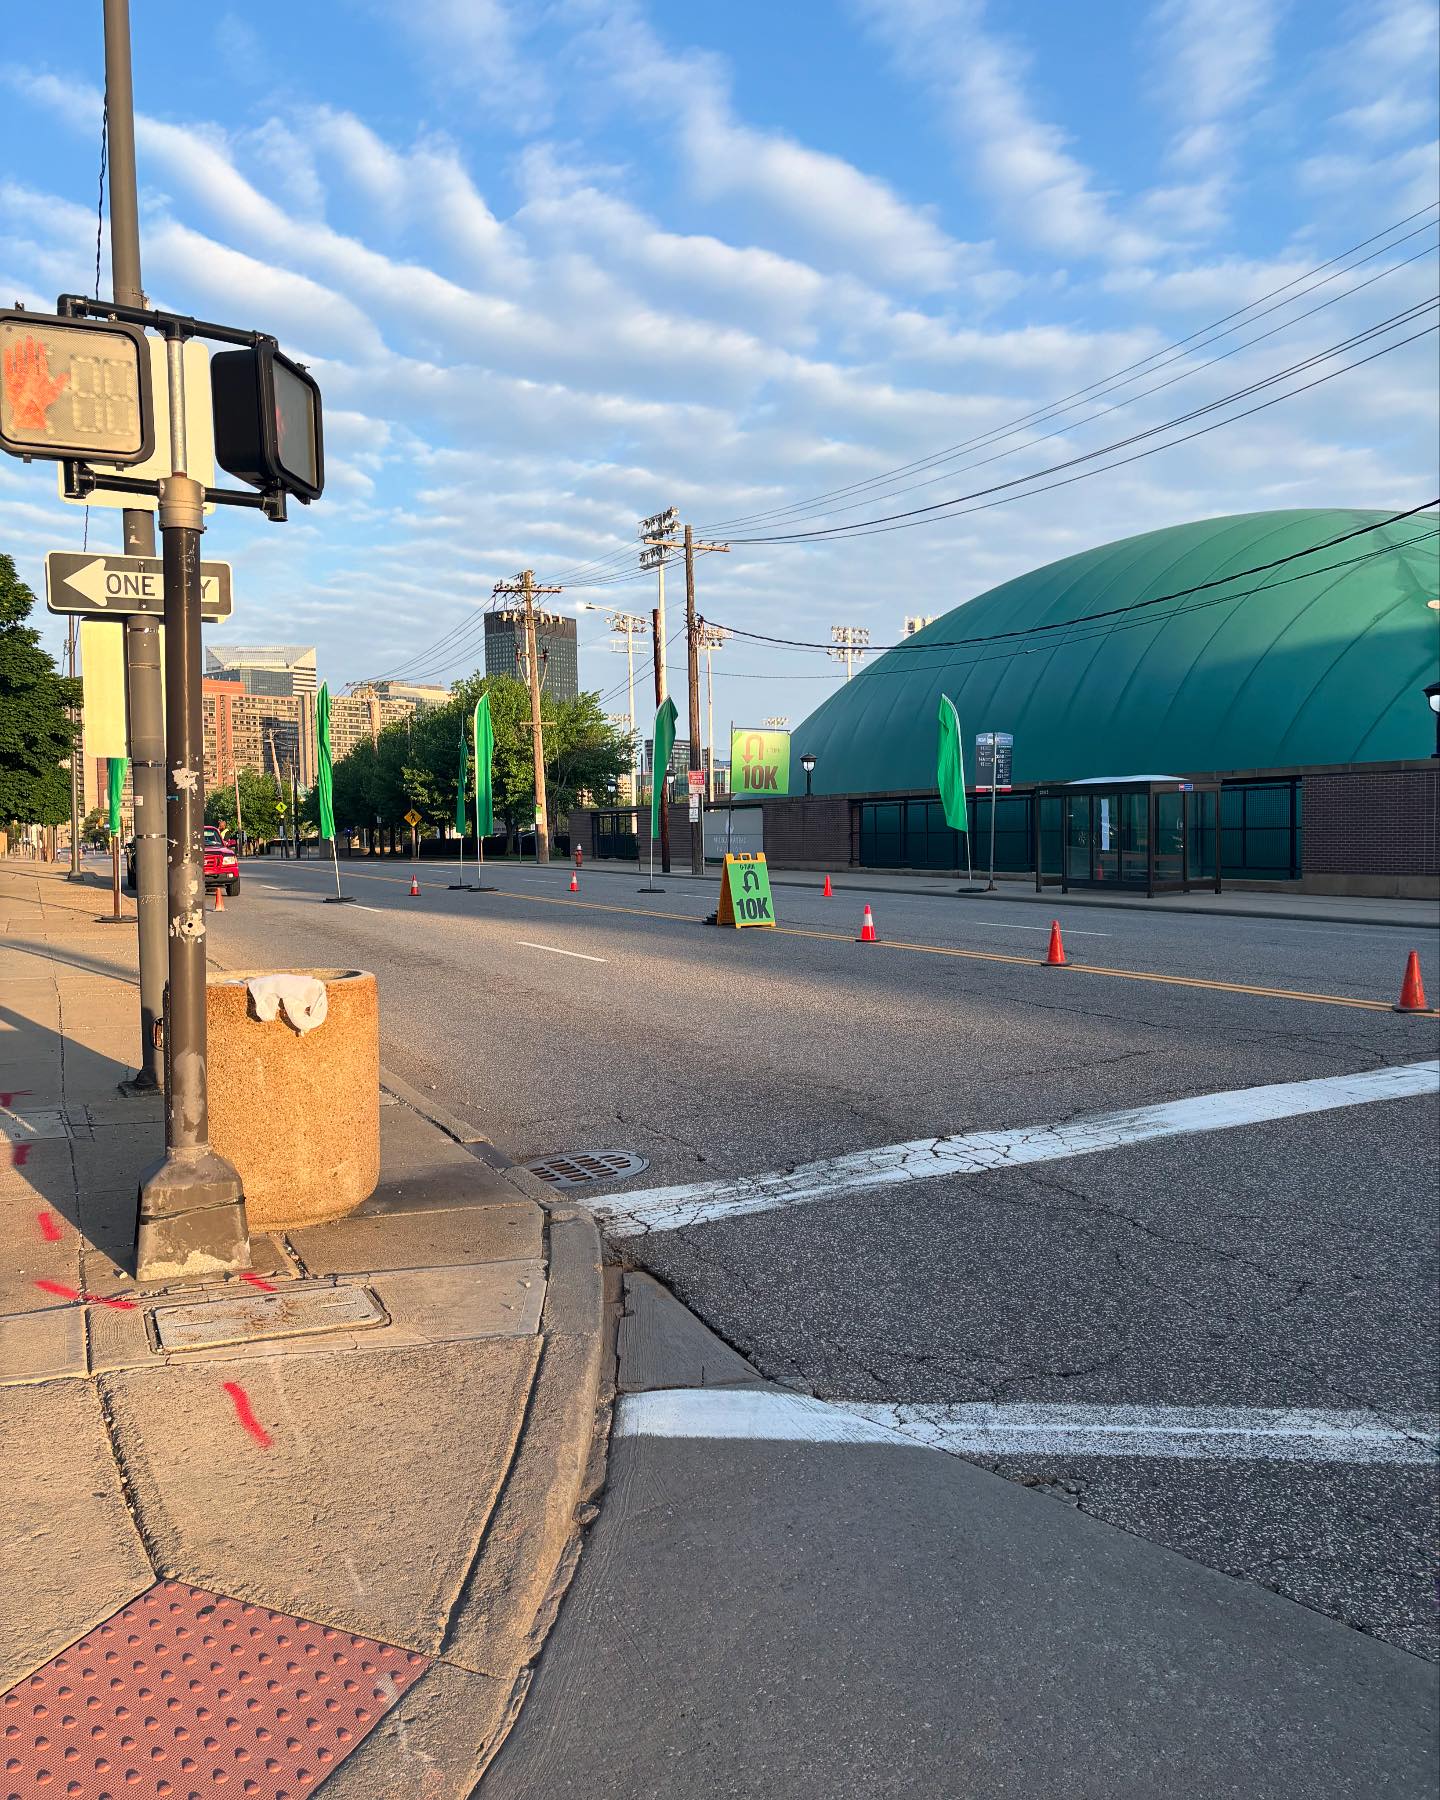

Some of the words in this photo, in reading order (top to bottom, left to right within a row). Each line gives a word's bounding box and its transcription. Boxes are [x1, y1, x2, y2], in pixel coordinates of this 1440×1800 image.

[107, 574, 156, 597] ONE
[742, 765, 778, 790] 10K
[736, 897, 771, 920] 10K
